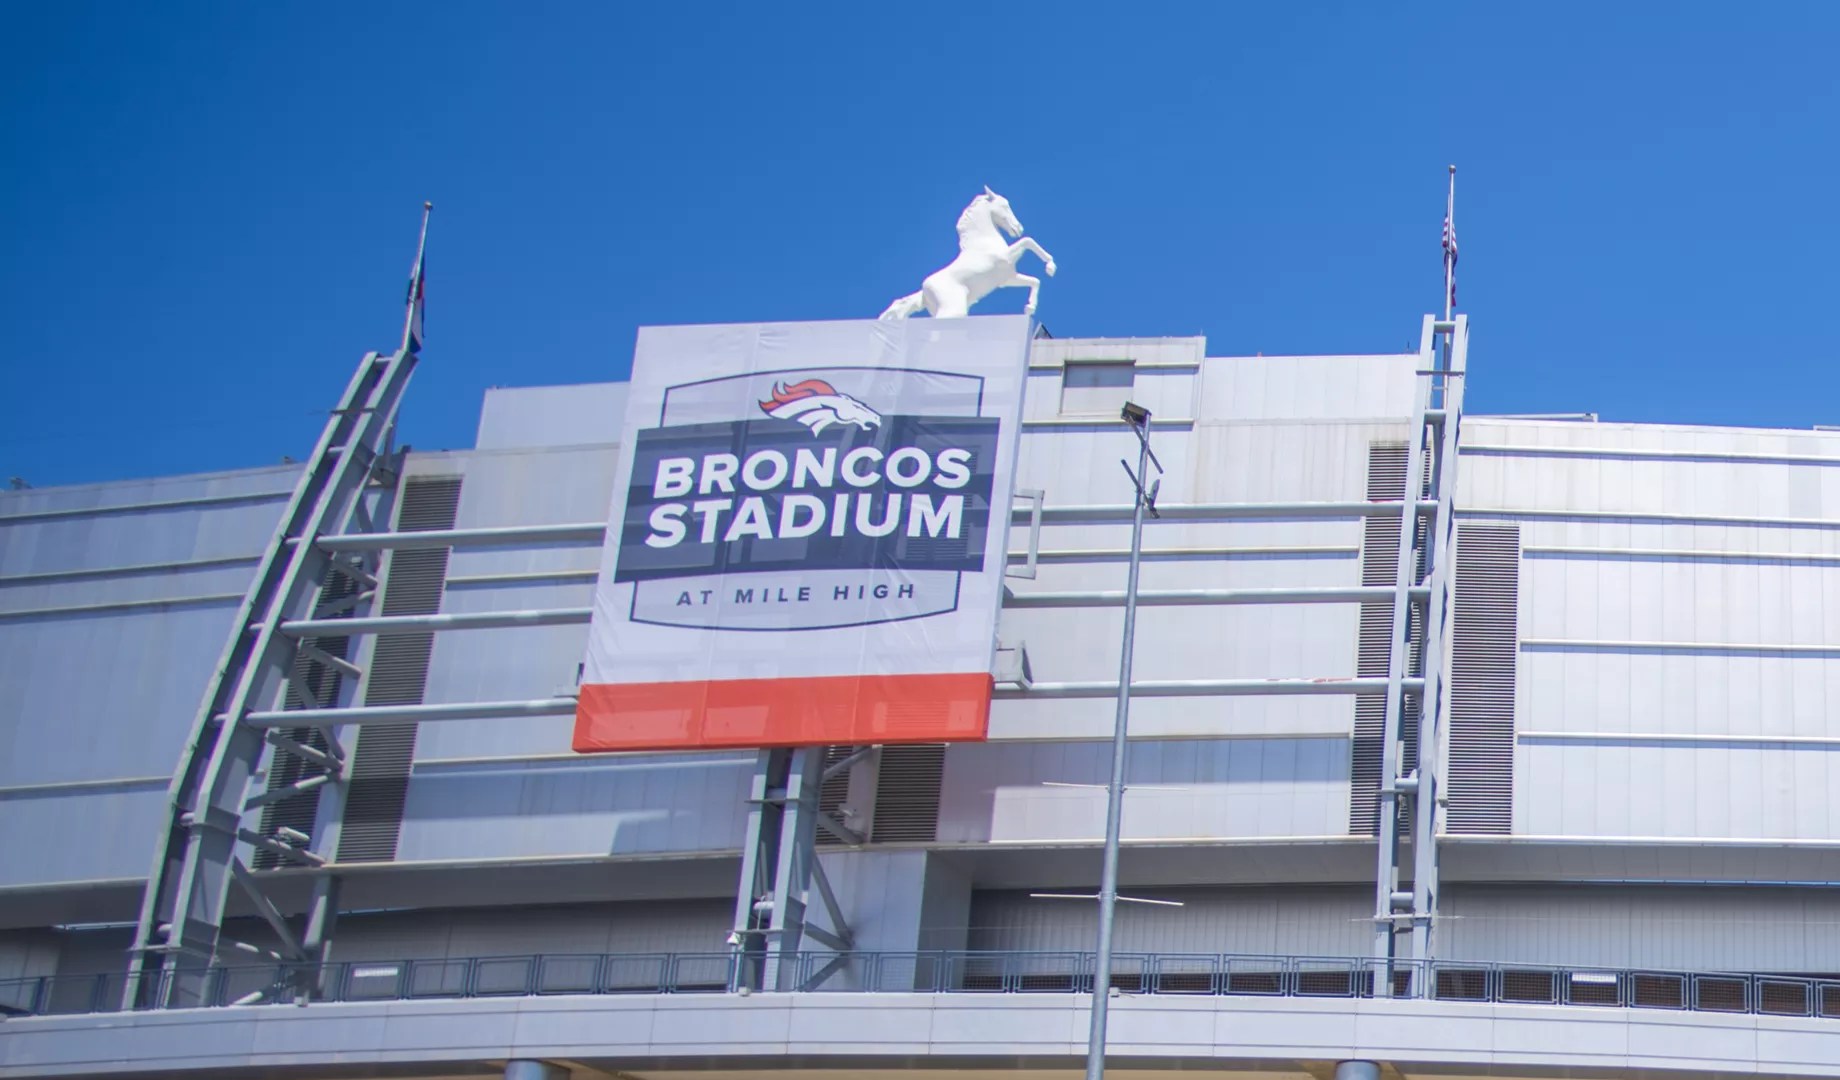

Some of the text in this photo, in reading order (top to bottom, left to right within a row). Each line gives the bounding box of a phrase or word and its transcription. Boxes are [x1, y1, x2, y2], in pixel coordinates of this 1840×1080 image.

[653, 447, 972, 498] BRONCOS
[645, 493, 964, 548] STADIUM
[677, 583, 915, 606] AT MILE HIGH
